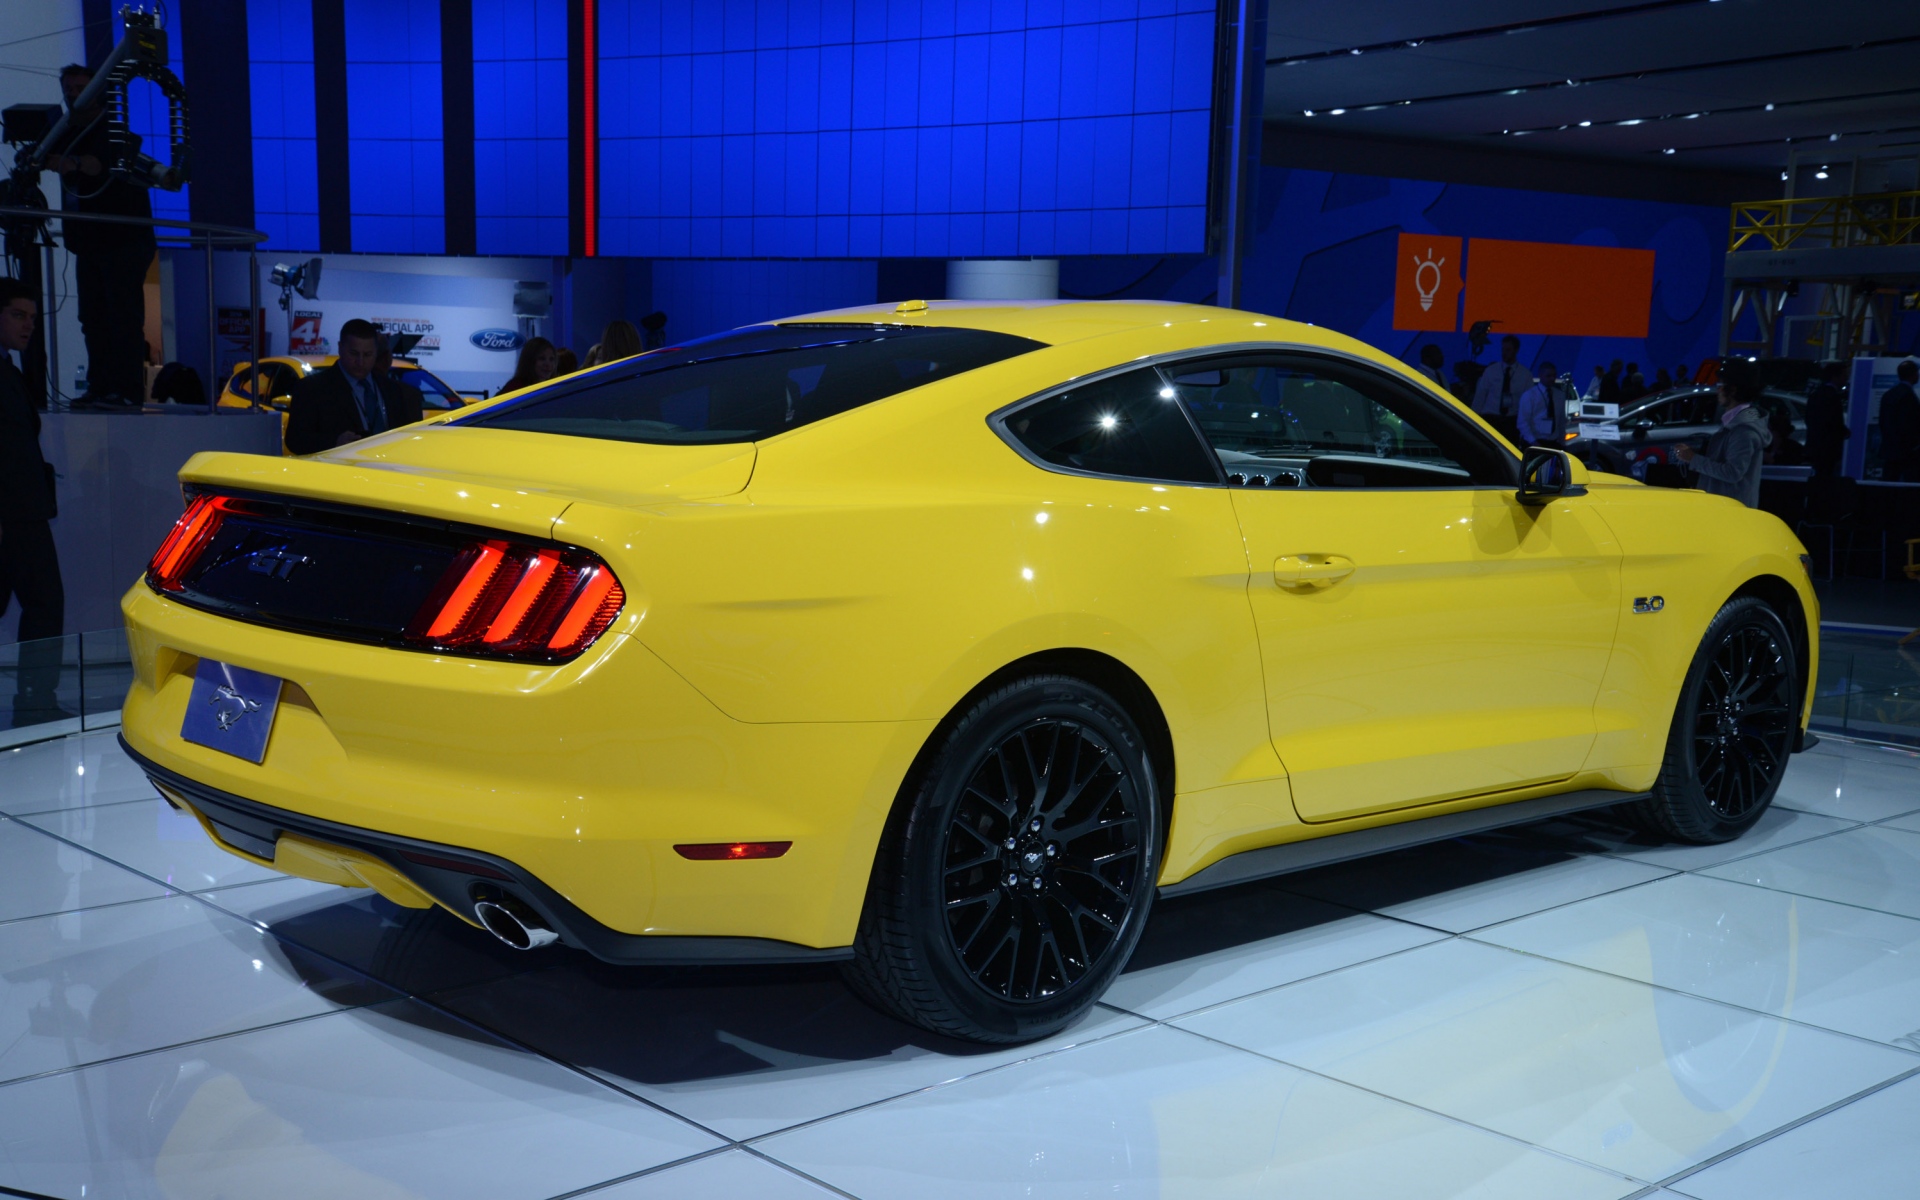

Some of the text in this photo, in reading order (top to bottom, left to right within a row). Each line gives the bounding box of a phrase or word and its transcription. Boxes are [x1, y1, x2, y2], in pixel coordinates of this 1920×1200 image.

[291, 320, 318, 344] 4
[414, 324, 434, 334] APP
[481, 332, 516, 348] Ford
[249, 549, 310, 580] GT
[1633, 596, 1665, 614] 5.0
